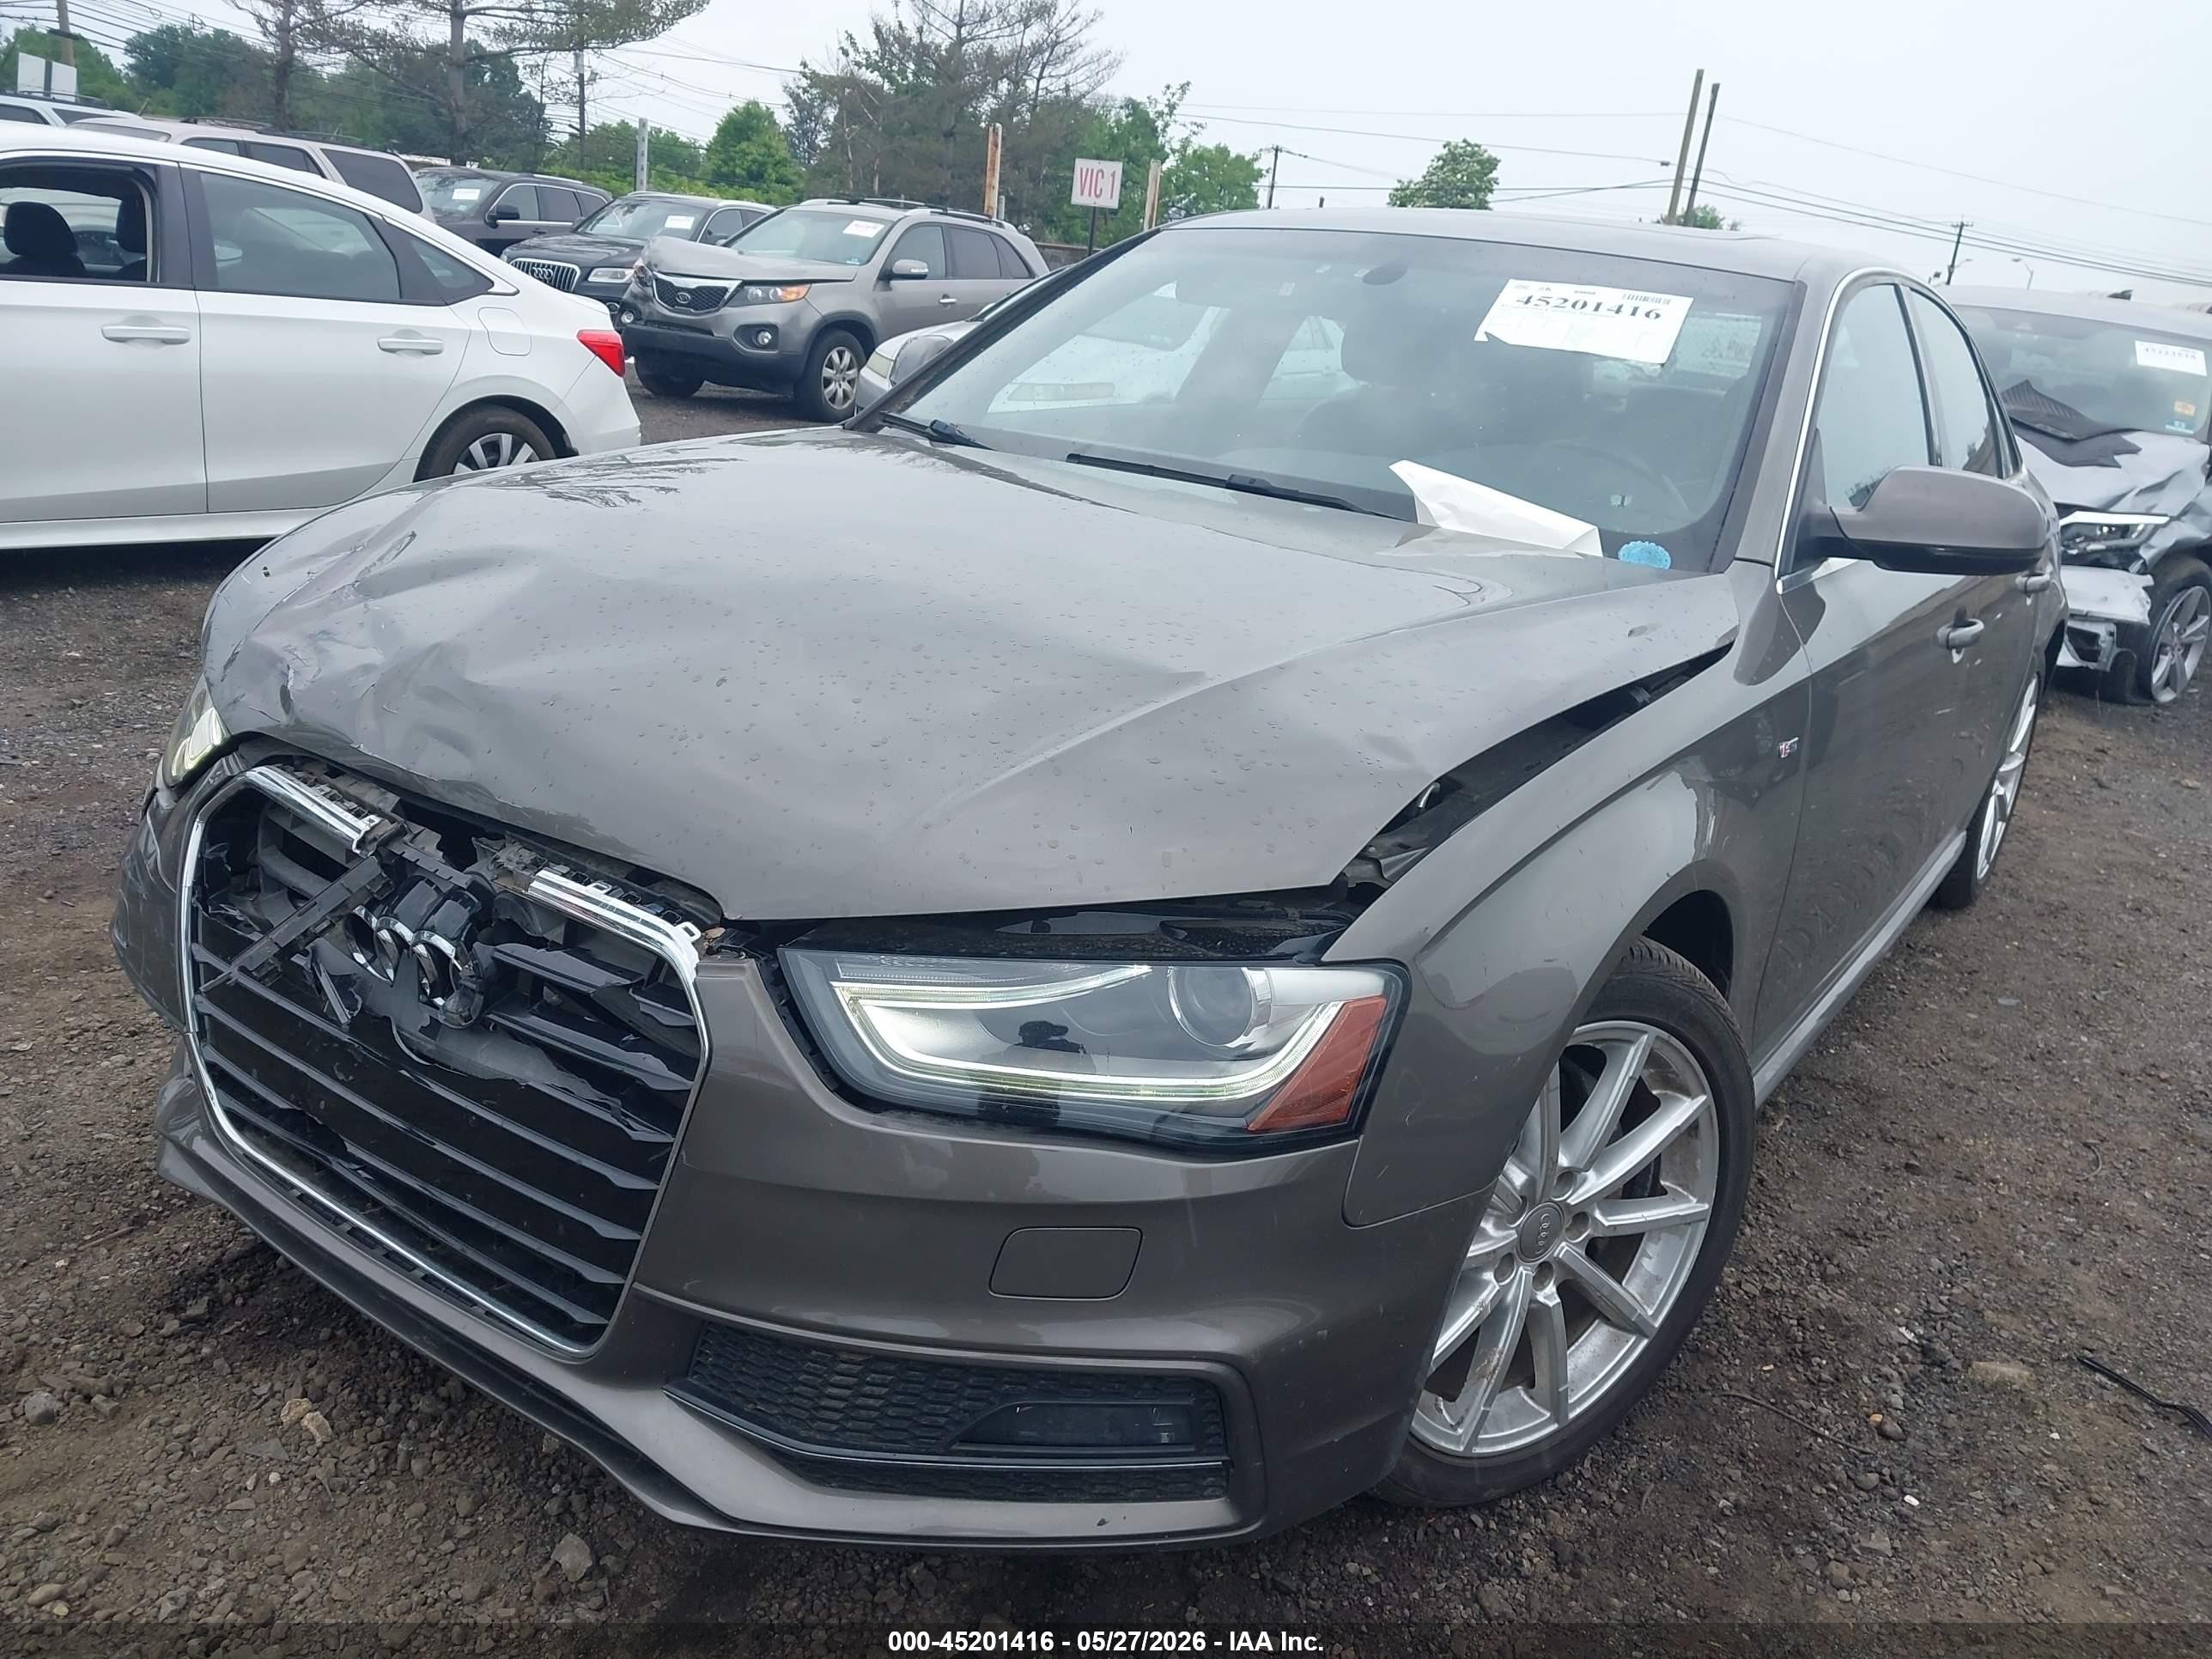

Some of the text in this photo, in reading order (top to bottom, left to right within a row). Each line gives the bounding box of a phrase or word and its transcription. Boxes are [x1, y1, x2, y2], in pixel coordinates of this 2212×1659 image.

[1079, 167, 1116, 200] VIC 1
[1516, 294, 1662, 320] 45201416
